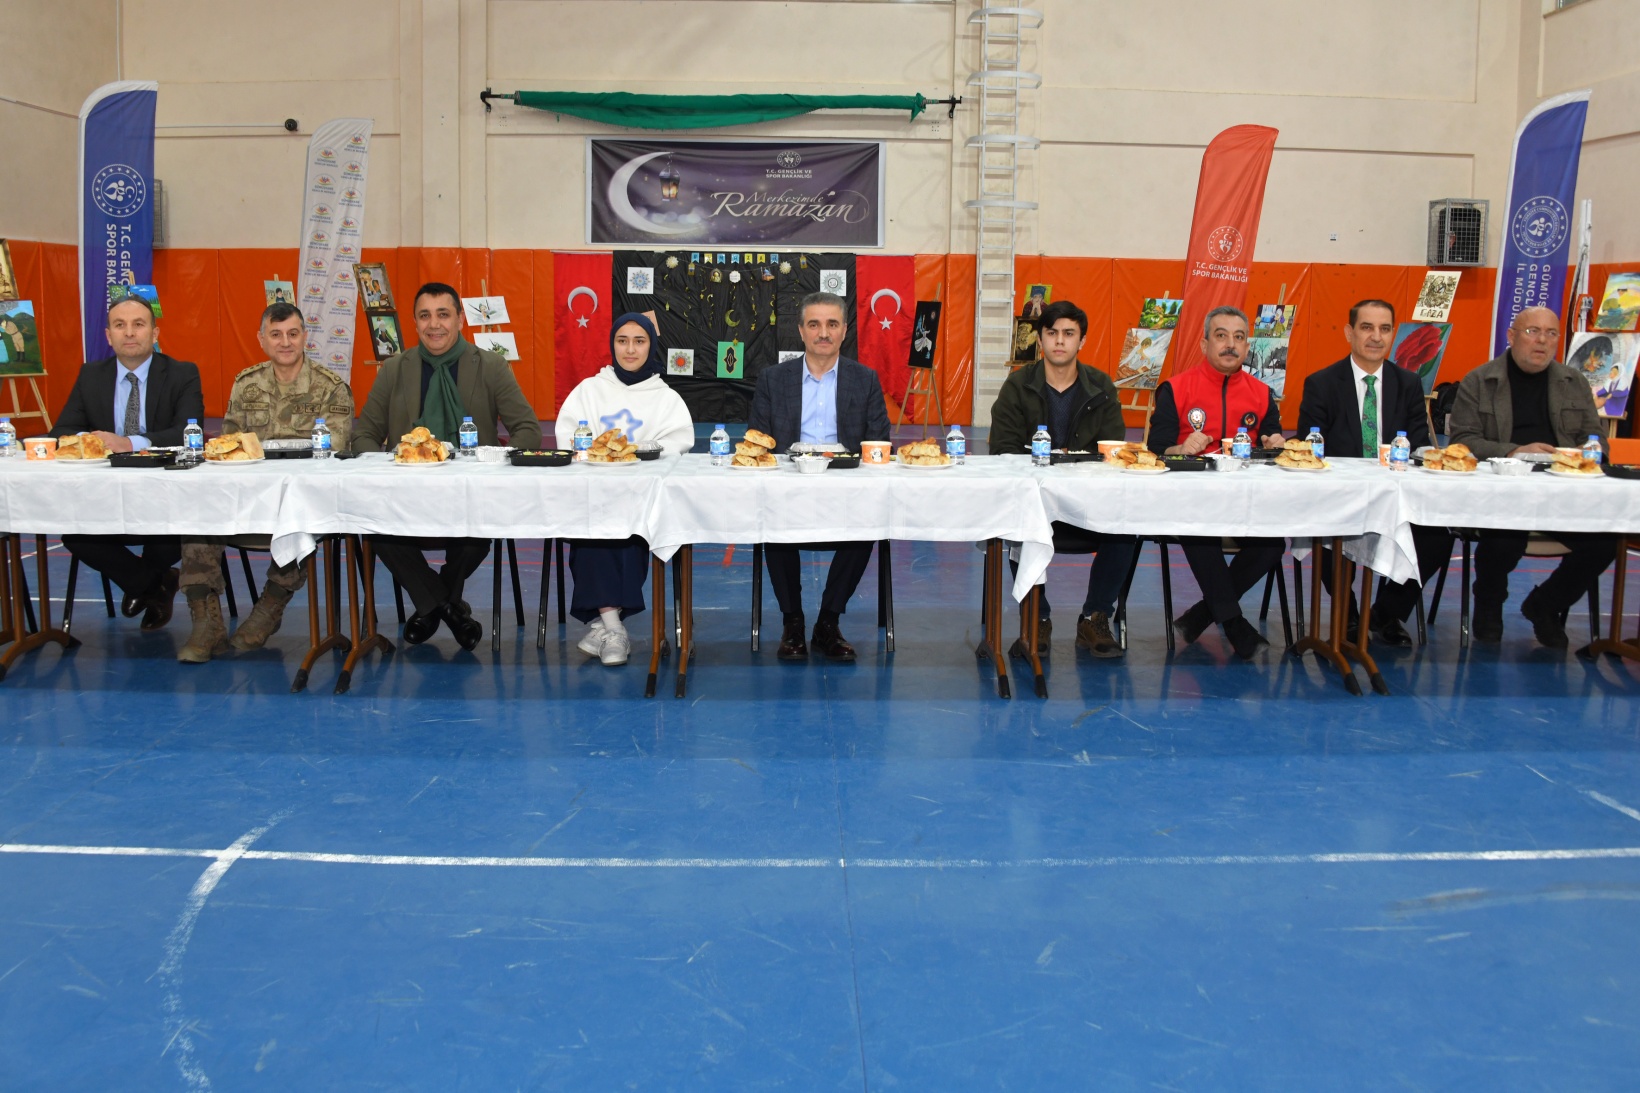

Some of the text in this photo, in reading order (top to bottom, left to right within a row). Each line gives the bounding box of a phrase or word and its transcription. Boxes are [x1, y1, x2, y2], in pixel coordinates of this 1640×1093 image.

[708, 190, 869, 223] Ramazan
[746, 189, 828, 204] Merkezimde
[106, 223, 117, 256] SPOR
[119, 224, 131, 286] T.C. GENÇ
[1192, 269, 1248, 282] SPOR BAKANLIĞI
[1209, 263, 1237, 273] GENÇLİK
[1517, 263, 1527, 274] İL
[1537, 264, 1551, 307] GÜMÜŞ
